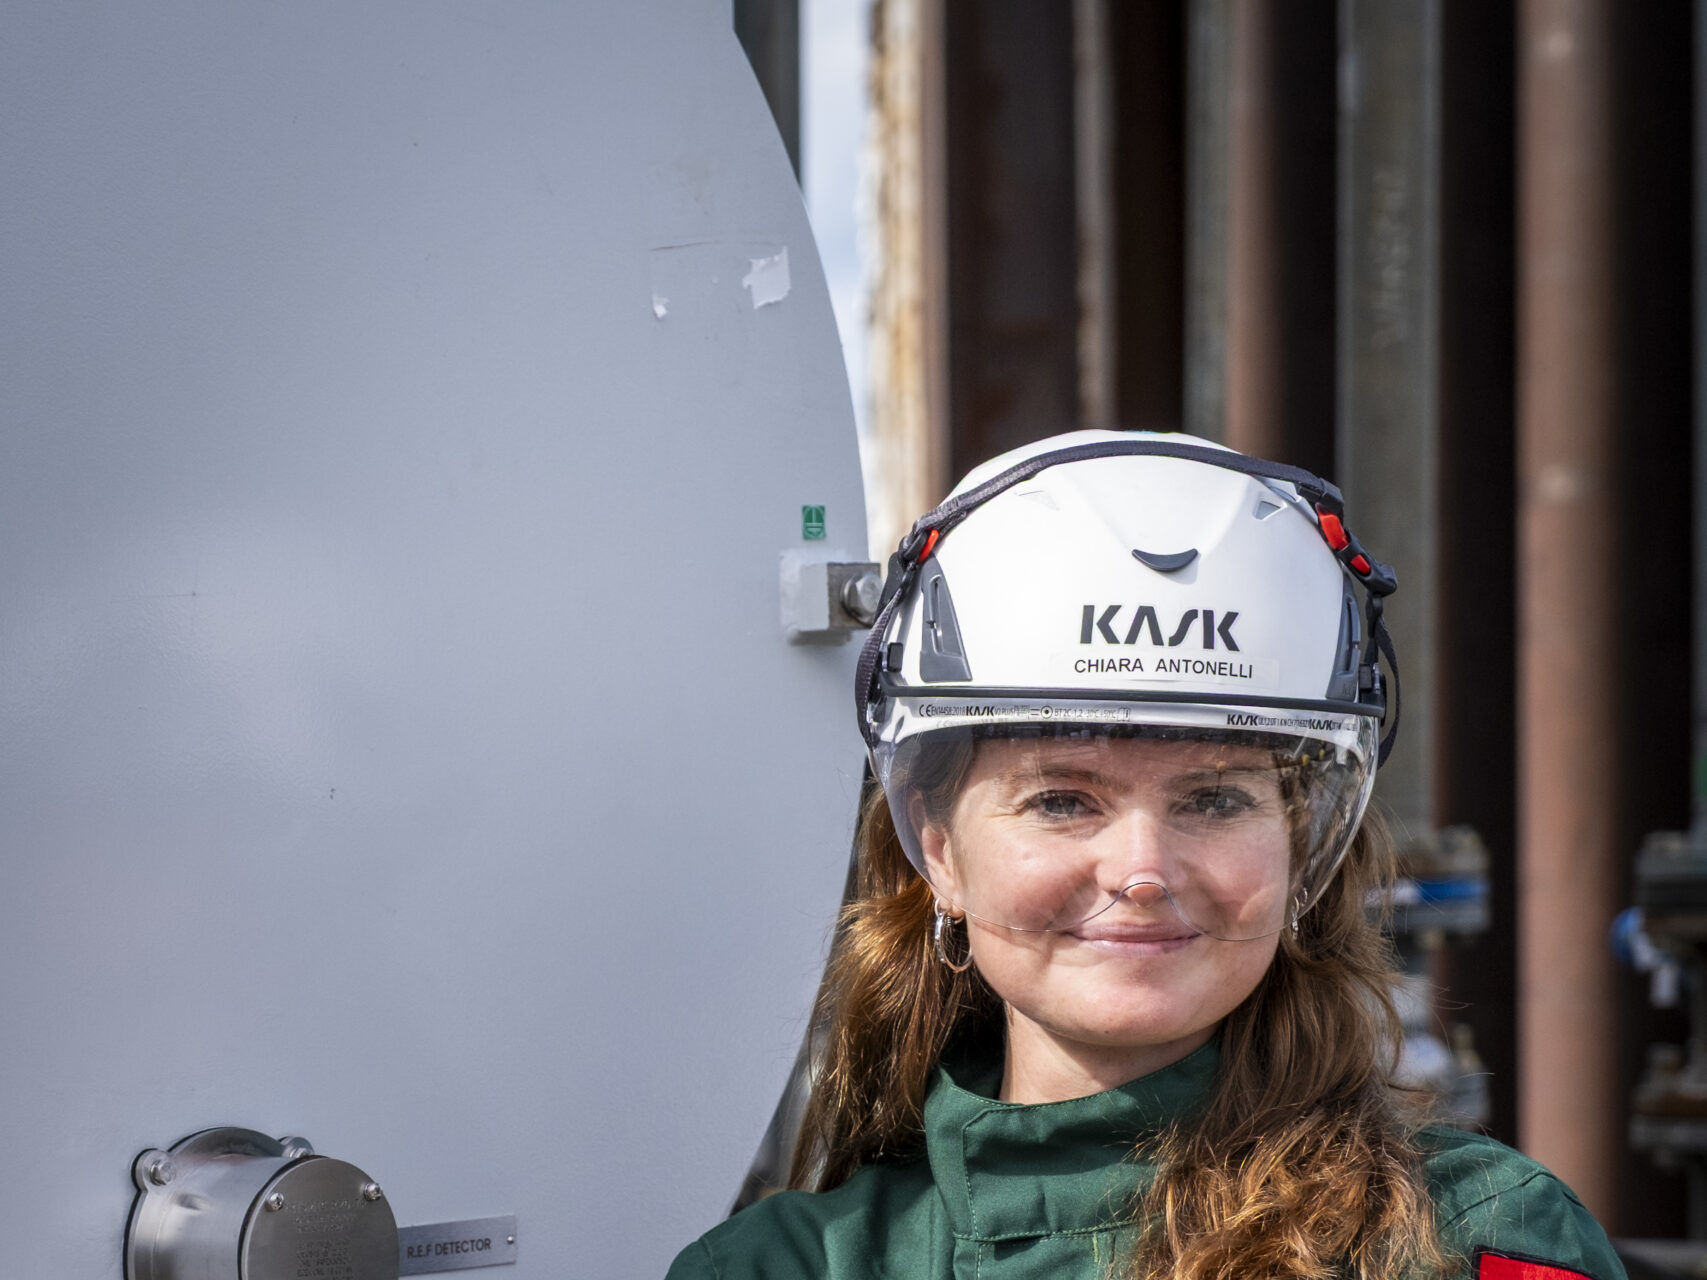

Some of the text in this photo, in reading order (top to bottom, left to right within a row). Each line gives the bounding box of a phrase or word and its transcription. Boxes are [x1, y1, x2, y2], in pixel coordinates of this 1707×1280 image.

[1079, 604, 1240, 652] KASK
[1074, 658, 1253, 679] CHIARA ANTONELLI
[966, 705, 995, 716] KASK
[1227, 713, 1258, 726] KASK
[434, 1238, 491, 1256] DETECTOR
